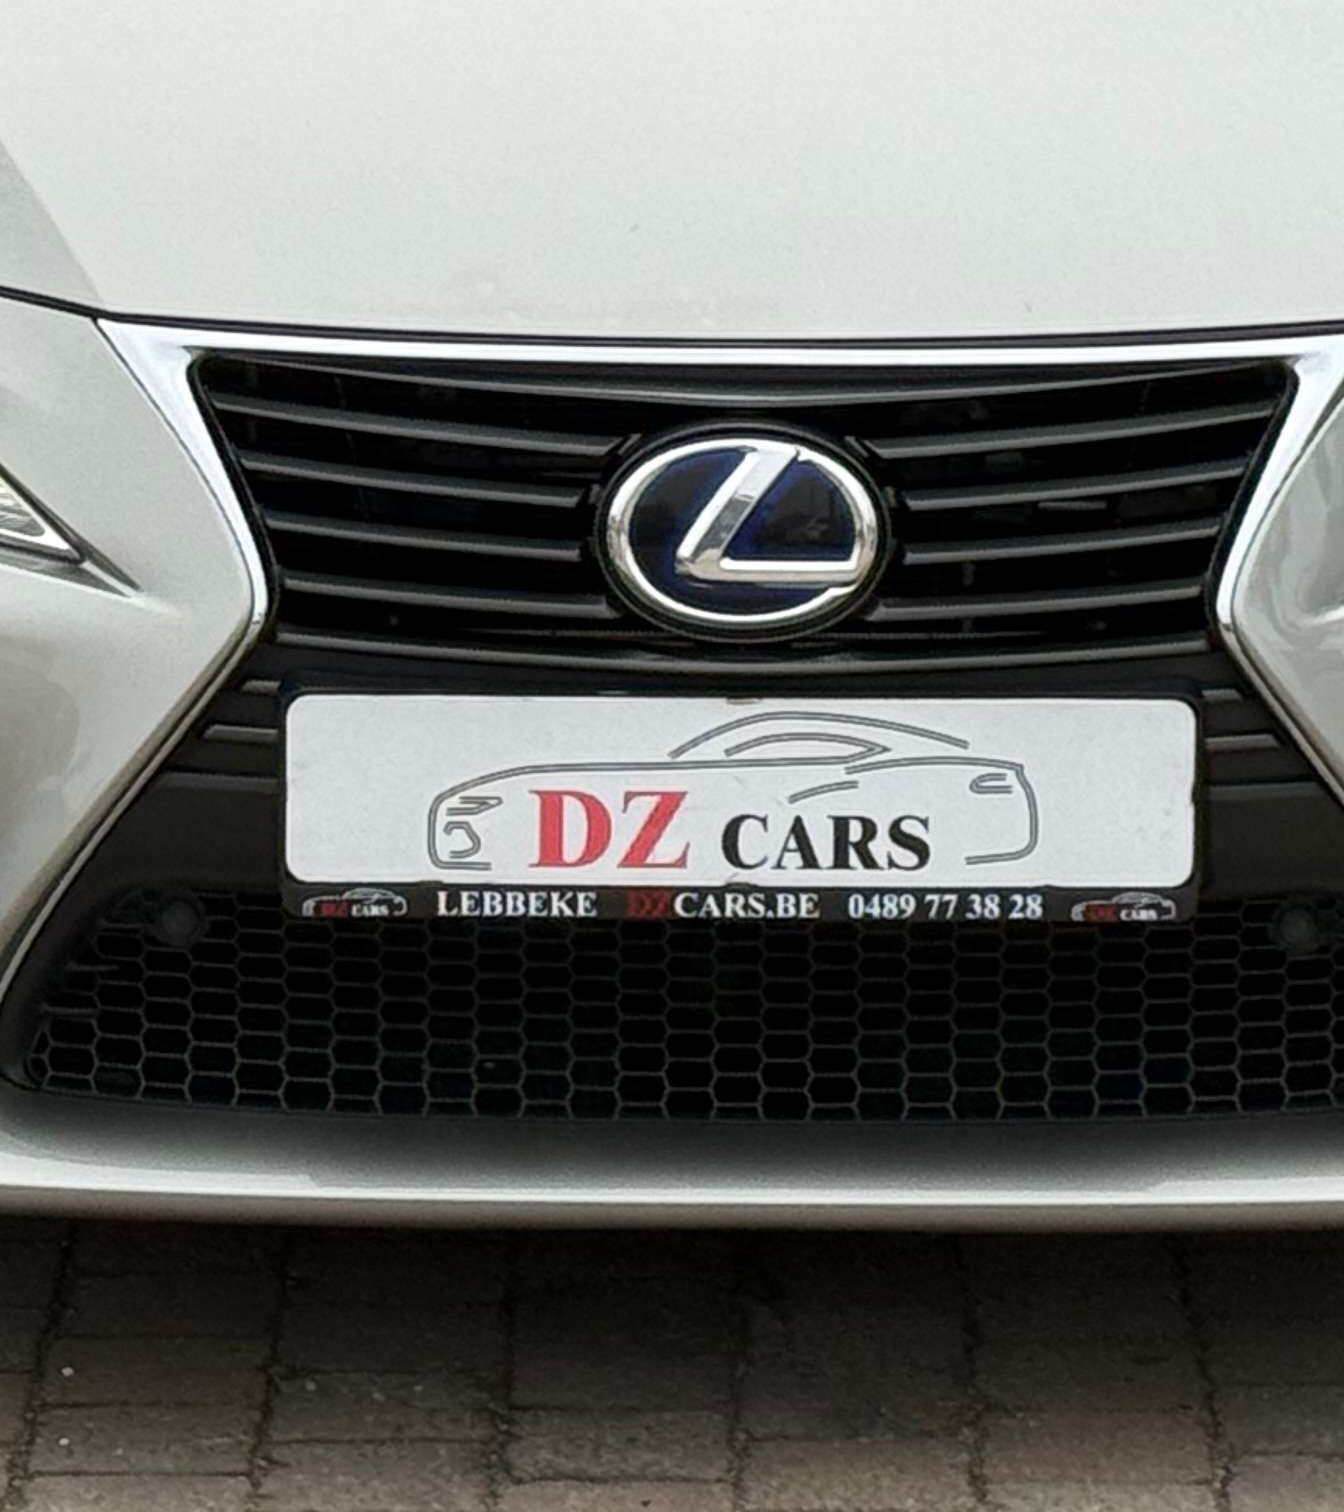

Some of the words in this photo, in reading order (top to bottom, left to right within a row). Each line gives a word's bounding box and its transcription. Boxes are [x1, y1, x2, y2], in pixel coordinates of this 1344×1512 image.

[528, 790, 692, 869] DZ
[721, 813, 932, 872] CARS
[437, 890, 598, 918] LEBBEKE
[626, 891, 822, 919] DZCARS.BE
[847, 893, 916, 920] 0489
[922, 894, 958, 920] 77
[964, 893, 1001, 920] 38
[1006, 893, 1044, 920] 28
